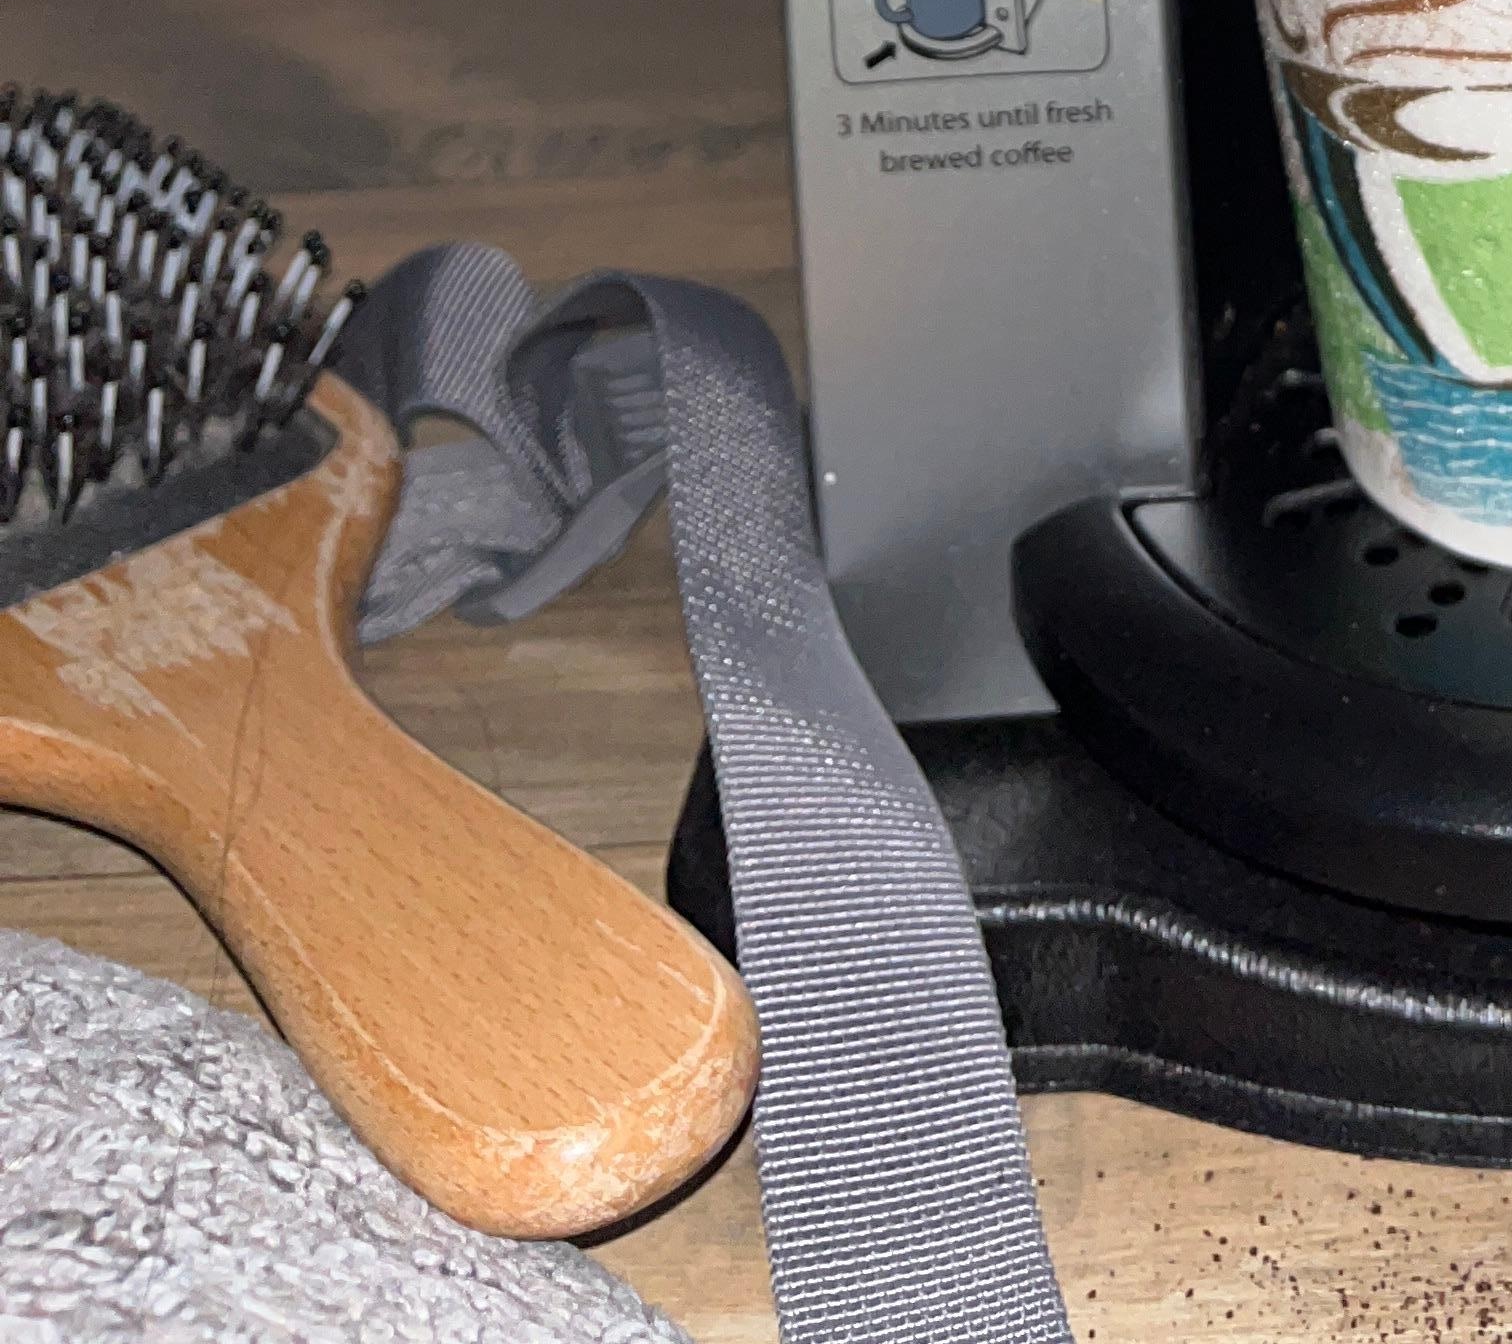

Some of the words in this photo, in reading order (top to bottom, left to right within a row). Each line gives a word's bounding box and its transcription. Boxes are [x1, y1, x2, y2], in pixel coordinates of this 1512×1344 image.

[835, 113, 852, 138] 3
[860, 110, 971, 134] Minutes
[978, 102, 1040, 129] until
[1045, 97, 1114, 125] fresh
[879, 143, 983, 173] brewed
[989, 139, 1074, 167] coffee
